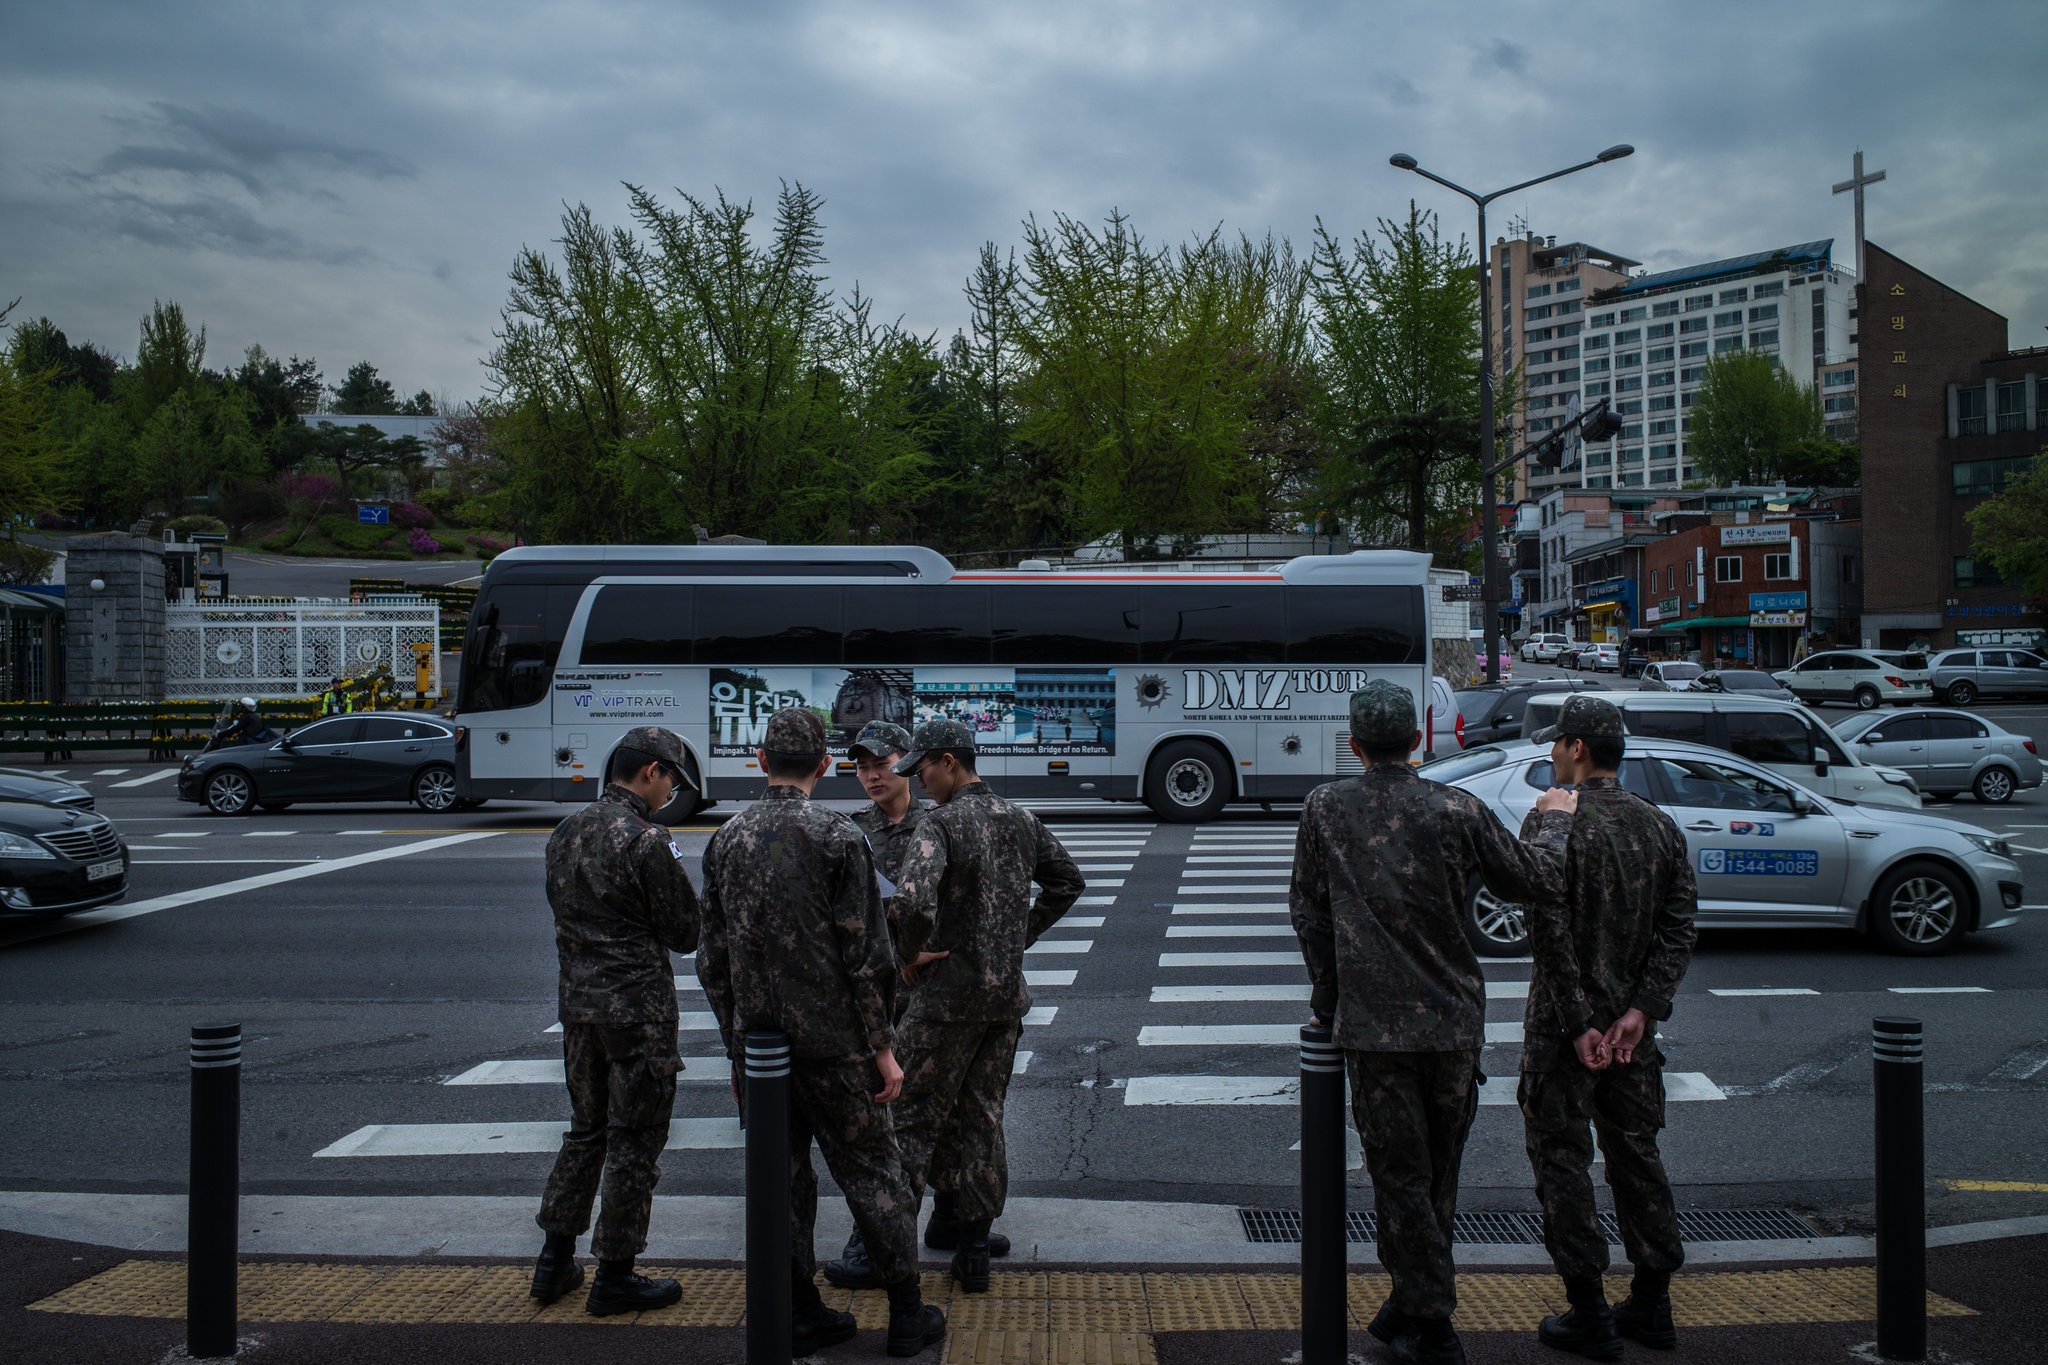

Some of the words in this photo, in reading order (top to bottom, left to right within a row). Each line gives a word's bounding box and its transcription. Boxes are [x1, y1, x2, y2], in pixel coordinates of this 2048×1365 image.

[1890, 283, 1907, 398] 소망교회
[1755, 597, 1801, 607] 마로니에
[1946, 604, 2023, 618] 소망어린이집
[1183, 669, 1290, 710] DMZ
[1292, 669, 1368, 693] TOUR
[589, 711, 663, 719] www.vviptravel.com
[714, 747, 747, 756] Imjingak.
[1038, 746, 1061, 755] Bridge
[1727, 860, 1816, 873] 1544-0085
